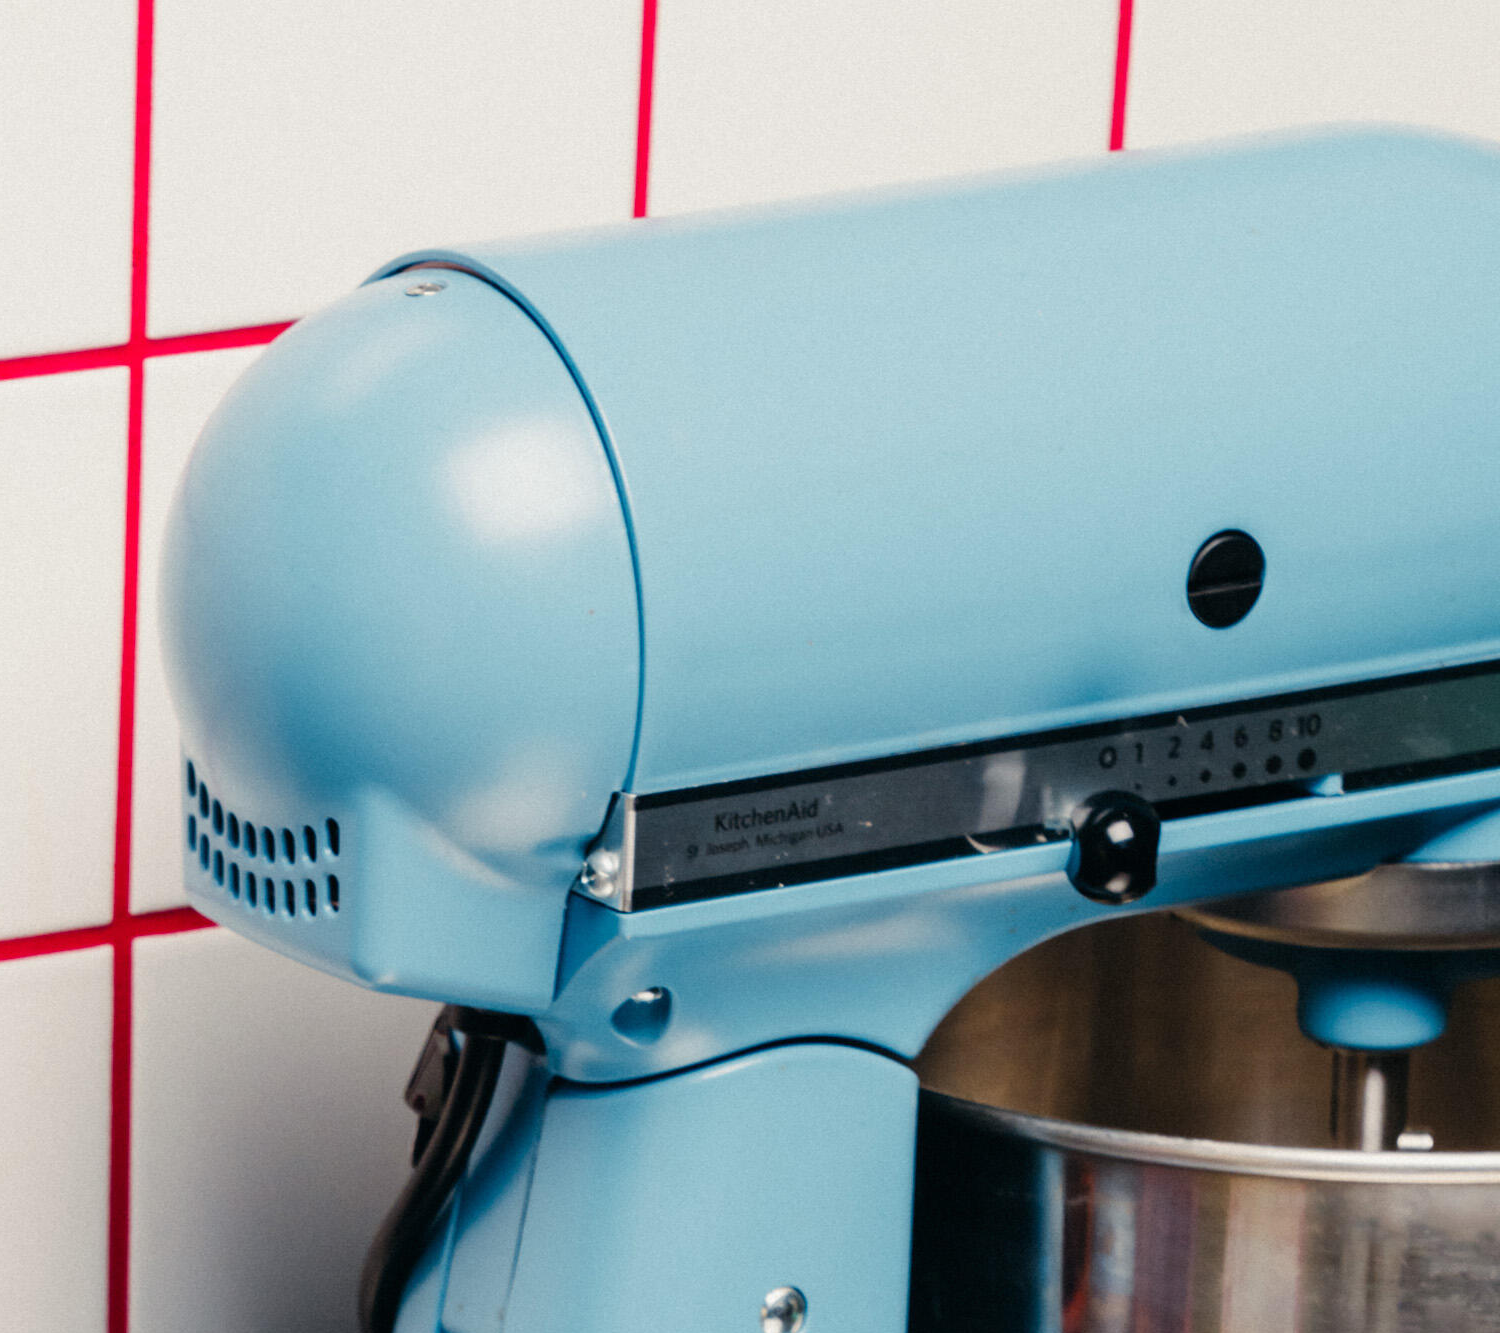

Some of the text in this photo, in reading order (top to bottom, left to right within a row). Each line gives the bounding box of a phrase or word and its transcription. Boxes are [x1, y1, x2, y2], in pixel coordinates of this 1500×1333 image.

[1099, 713, 1322, 769] 0 1 2 4 6 8 10
[714, 798, 819, 833] KitchenAid
